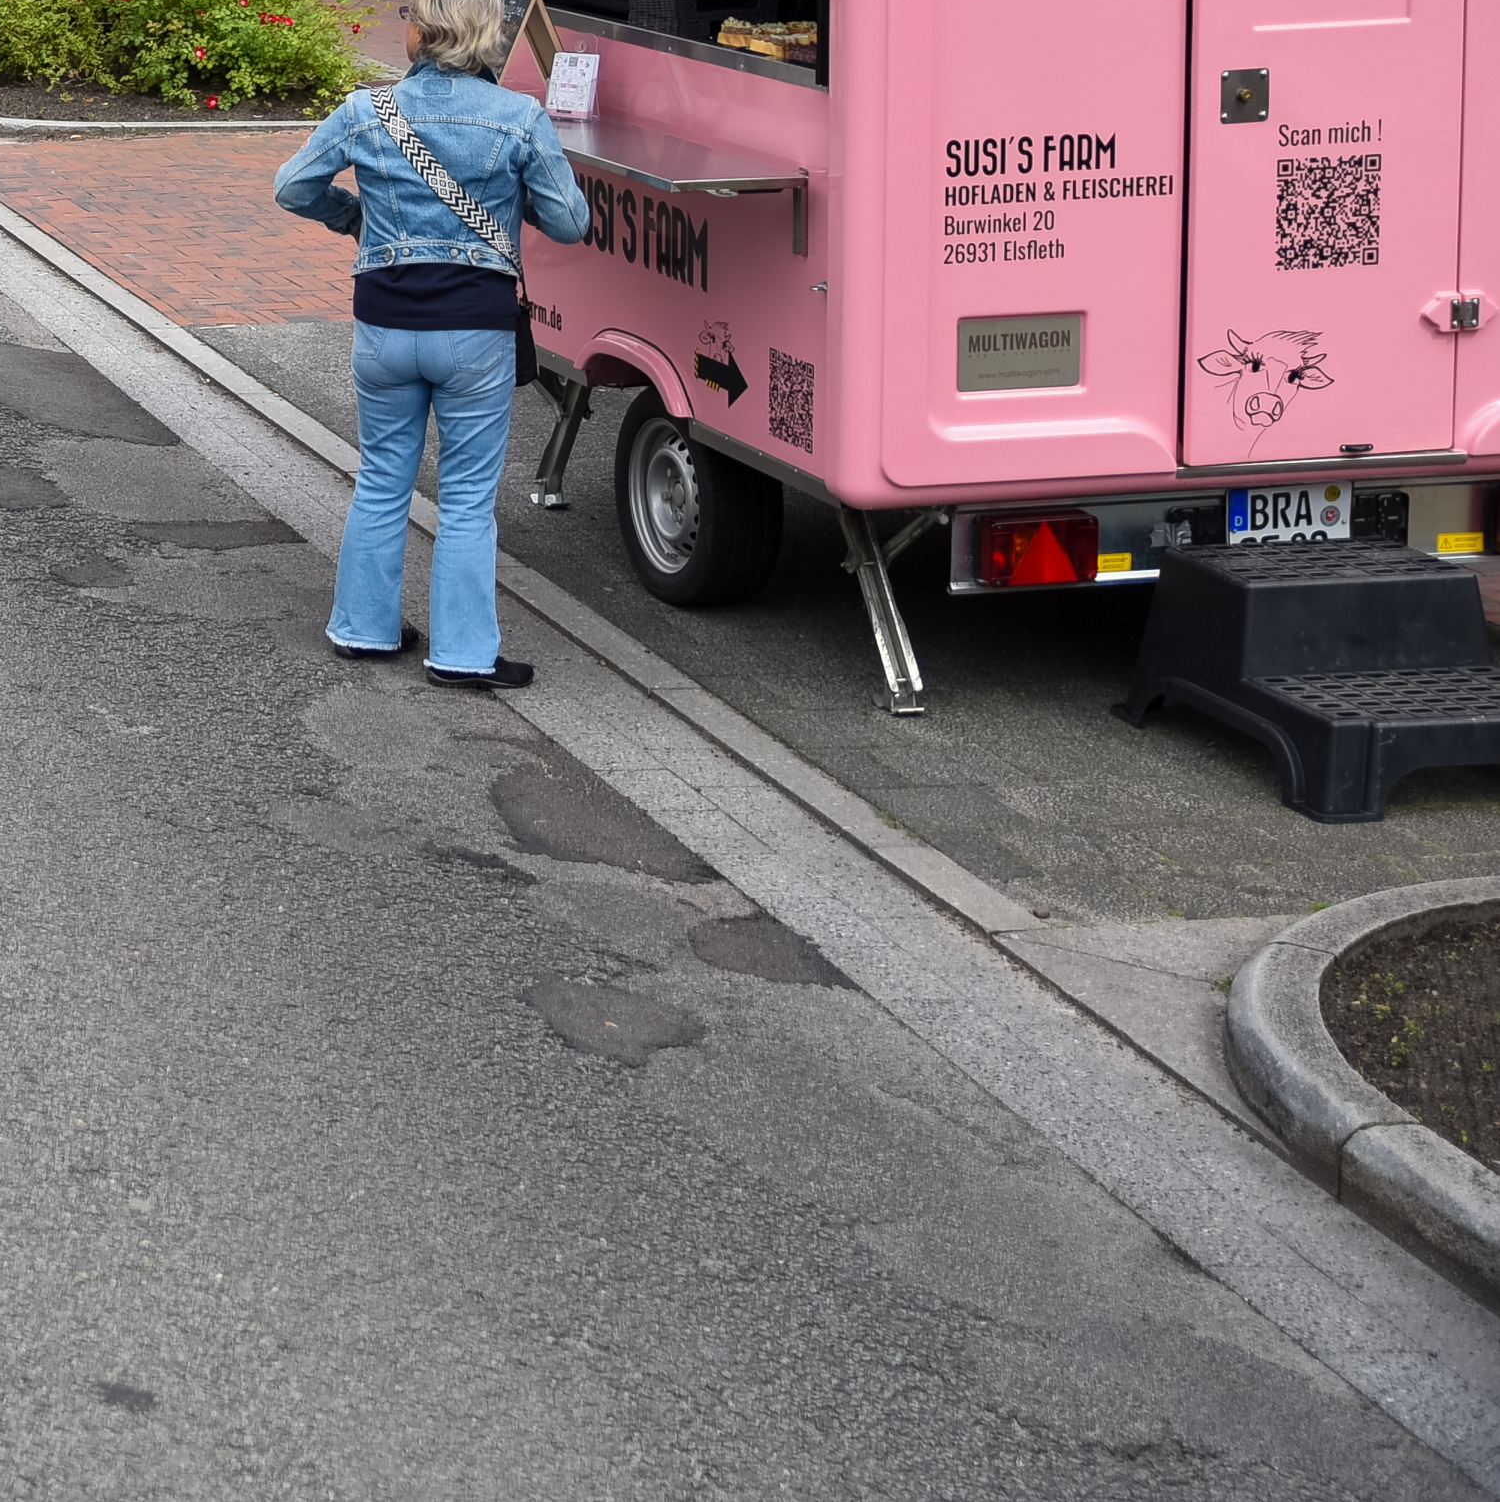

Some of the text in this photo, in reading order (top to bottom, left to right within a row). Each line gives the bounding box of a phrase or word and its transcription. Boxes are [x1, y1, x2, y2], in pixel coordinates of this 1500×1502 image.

[1278, 124, 1321, 147] Scan
[1328, 120, 1371, 144] mich
[946, 132, 1116, 178] SUSI'S FARM
[944, 175, 1174, 207] HOFLADEN & FLEISCHEREI
[577, 173, 709, 293] USI'S FARM
[944, 210, 1055, 236] Burwinkel 20
[943, 238, 1065, 265] 26931 Elsfleth
[529, 300, 563, 332] arm.de
[968, 330, 1071, 354] MULTIWAGON
[1235, 516, 1243, 527] D
[1250, 490, 1313, 531] BRA
